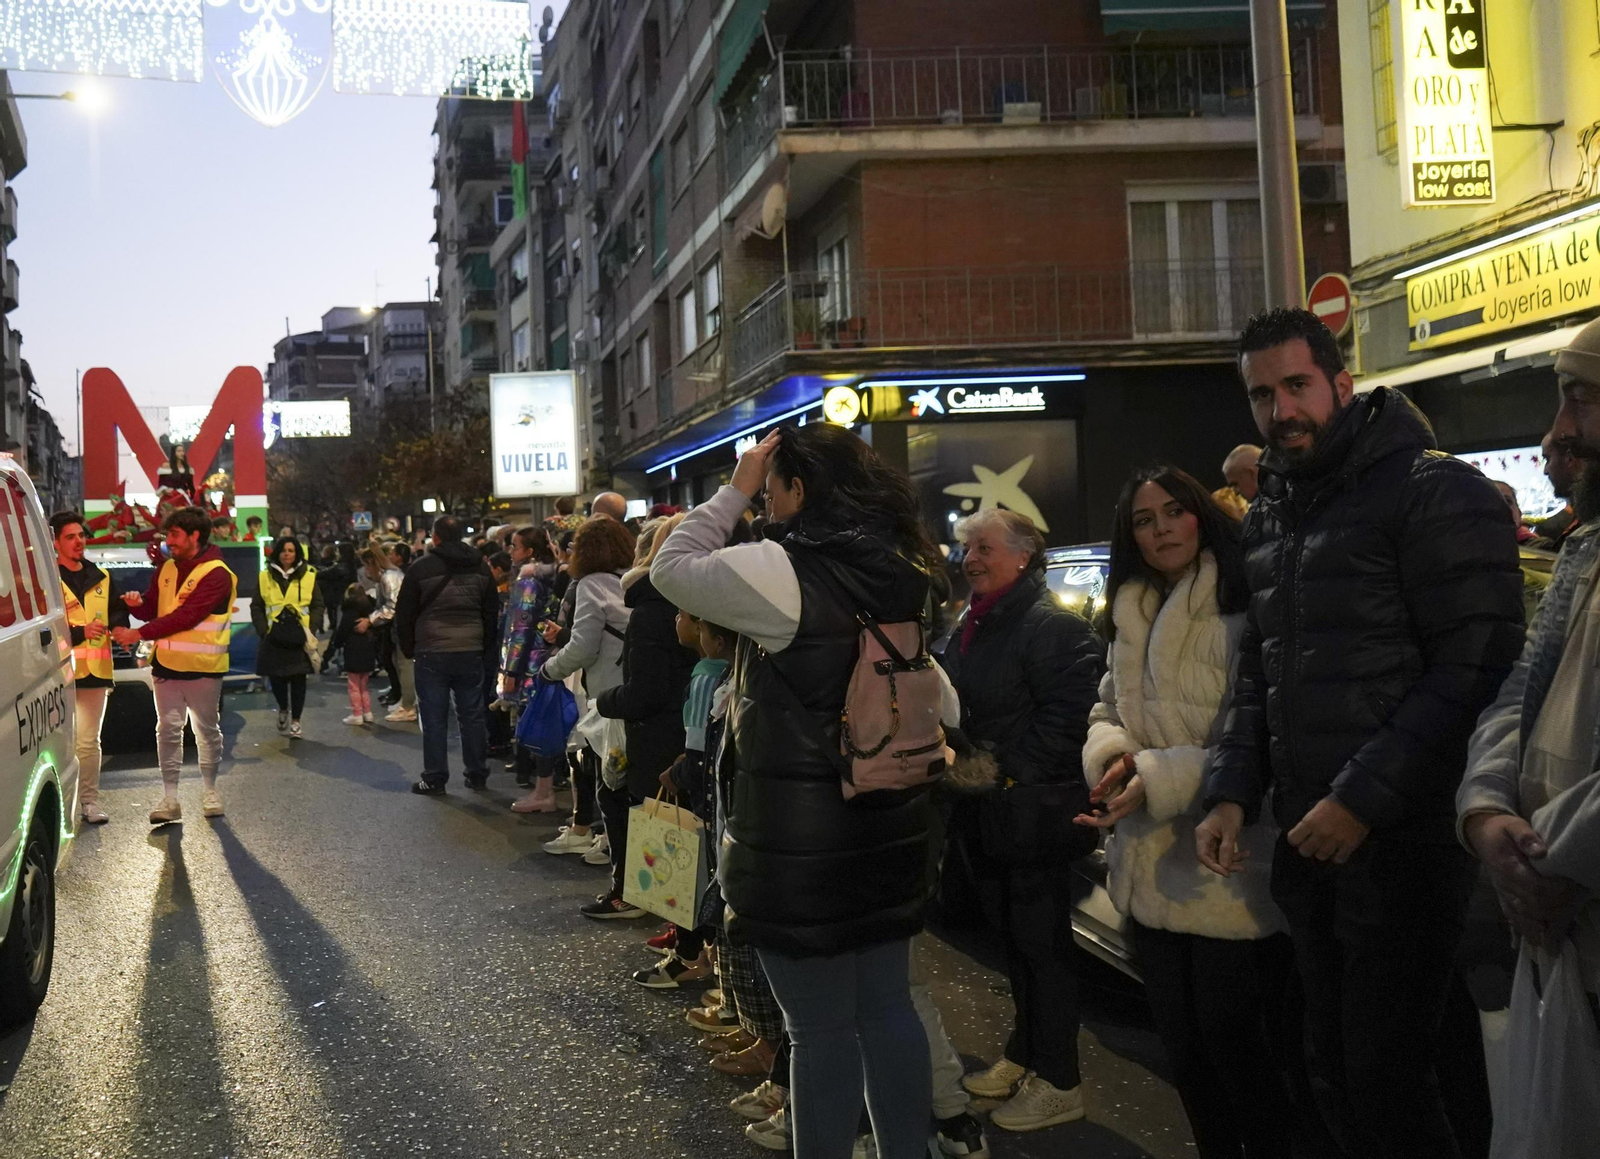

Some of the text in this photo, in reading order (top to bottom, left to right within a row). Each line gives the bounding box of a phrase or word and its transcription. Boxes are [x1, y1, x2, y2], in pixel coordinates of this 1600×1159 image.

[1449, 25, 1478, 55] de
[1414, 75, 1462, 106] ORO
[1415, 123, 1486, 156] PLATA
[1418, 180, 1491, 199] low cost
[1410, 264, 1486, 314] COMPRA
[1491, 240, 1560, 288] VENTA
[1566, 230, 1590, 267] de
[1489, 276, 1592, 324] Joyería low
[946, 385, 1046, 409] CaixaBank
[502, 451, 569, 473] VIVELA
[15, 683, 66, 758] Express
